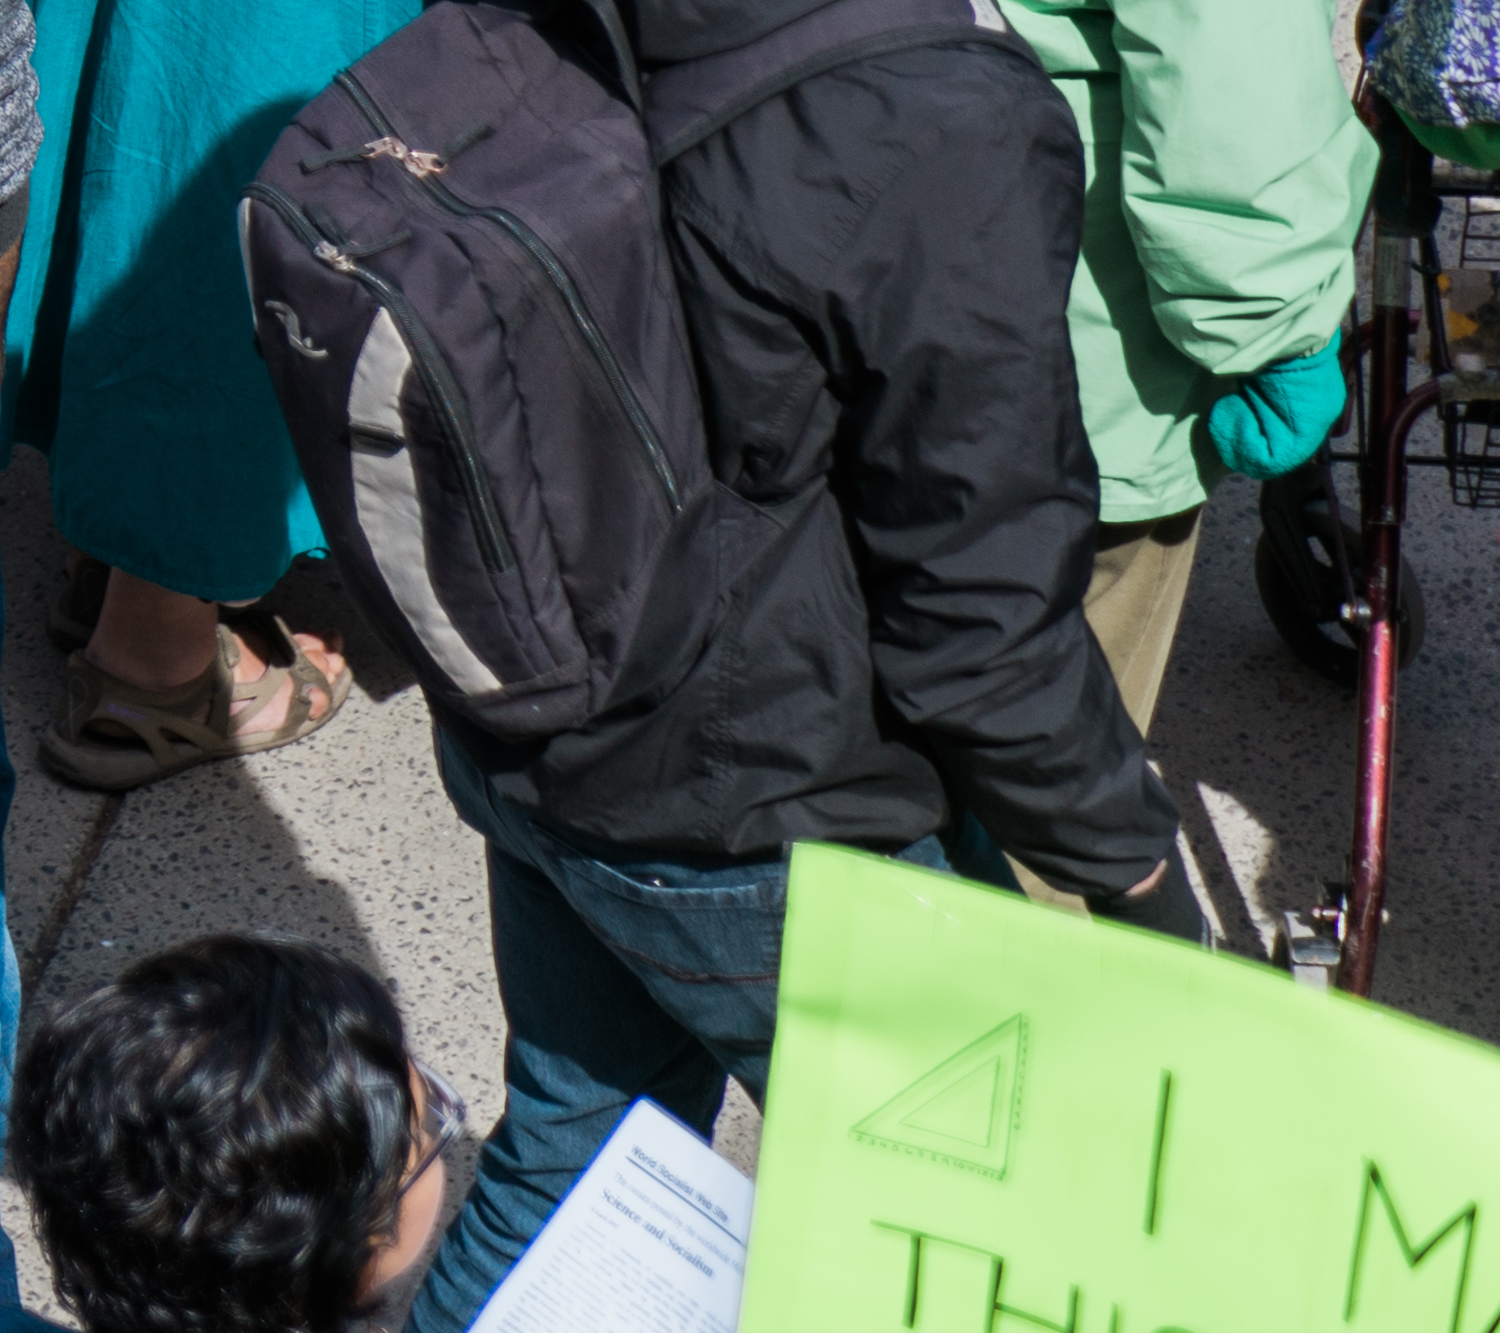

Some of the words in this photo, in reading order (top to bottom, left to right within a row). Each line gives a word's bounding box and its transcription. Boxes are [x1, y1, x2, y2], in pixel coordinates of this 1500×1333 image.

[629, 1144, 658, 1170] World
[656, 1164, 695, 1197] Socialist
[694, 1192, 714, 1211] Web
[712, 1205, 730, 1224] Site
[1142, 1067, 1174, 1236] I
[1341, 1153, 1500, 1333] M
[600, 1186, 644, 1224] Science
[642, 1218, 665, 1240] and
[664, 1234, 716, 1278] Socialism
